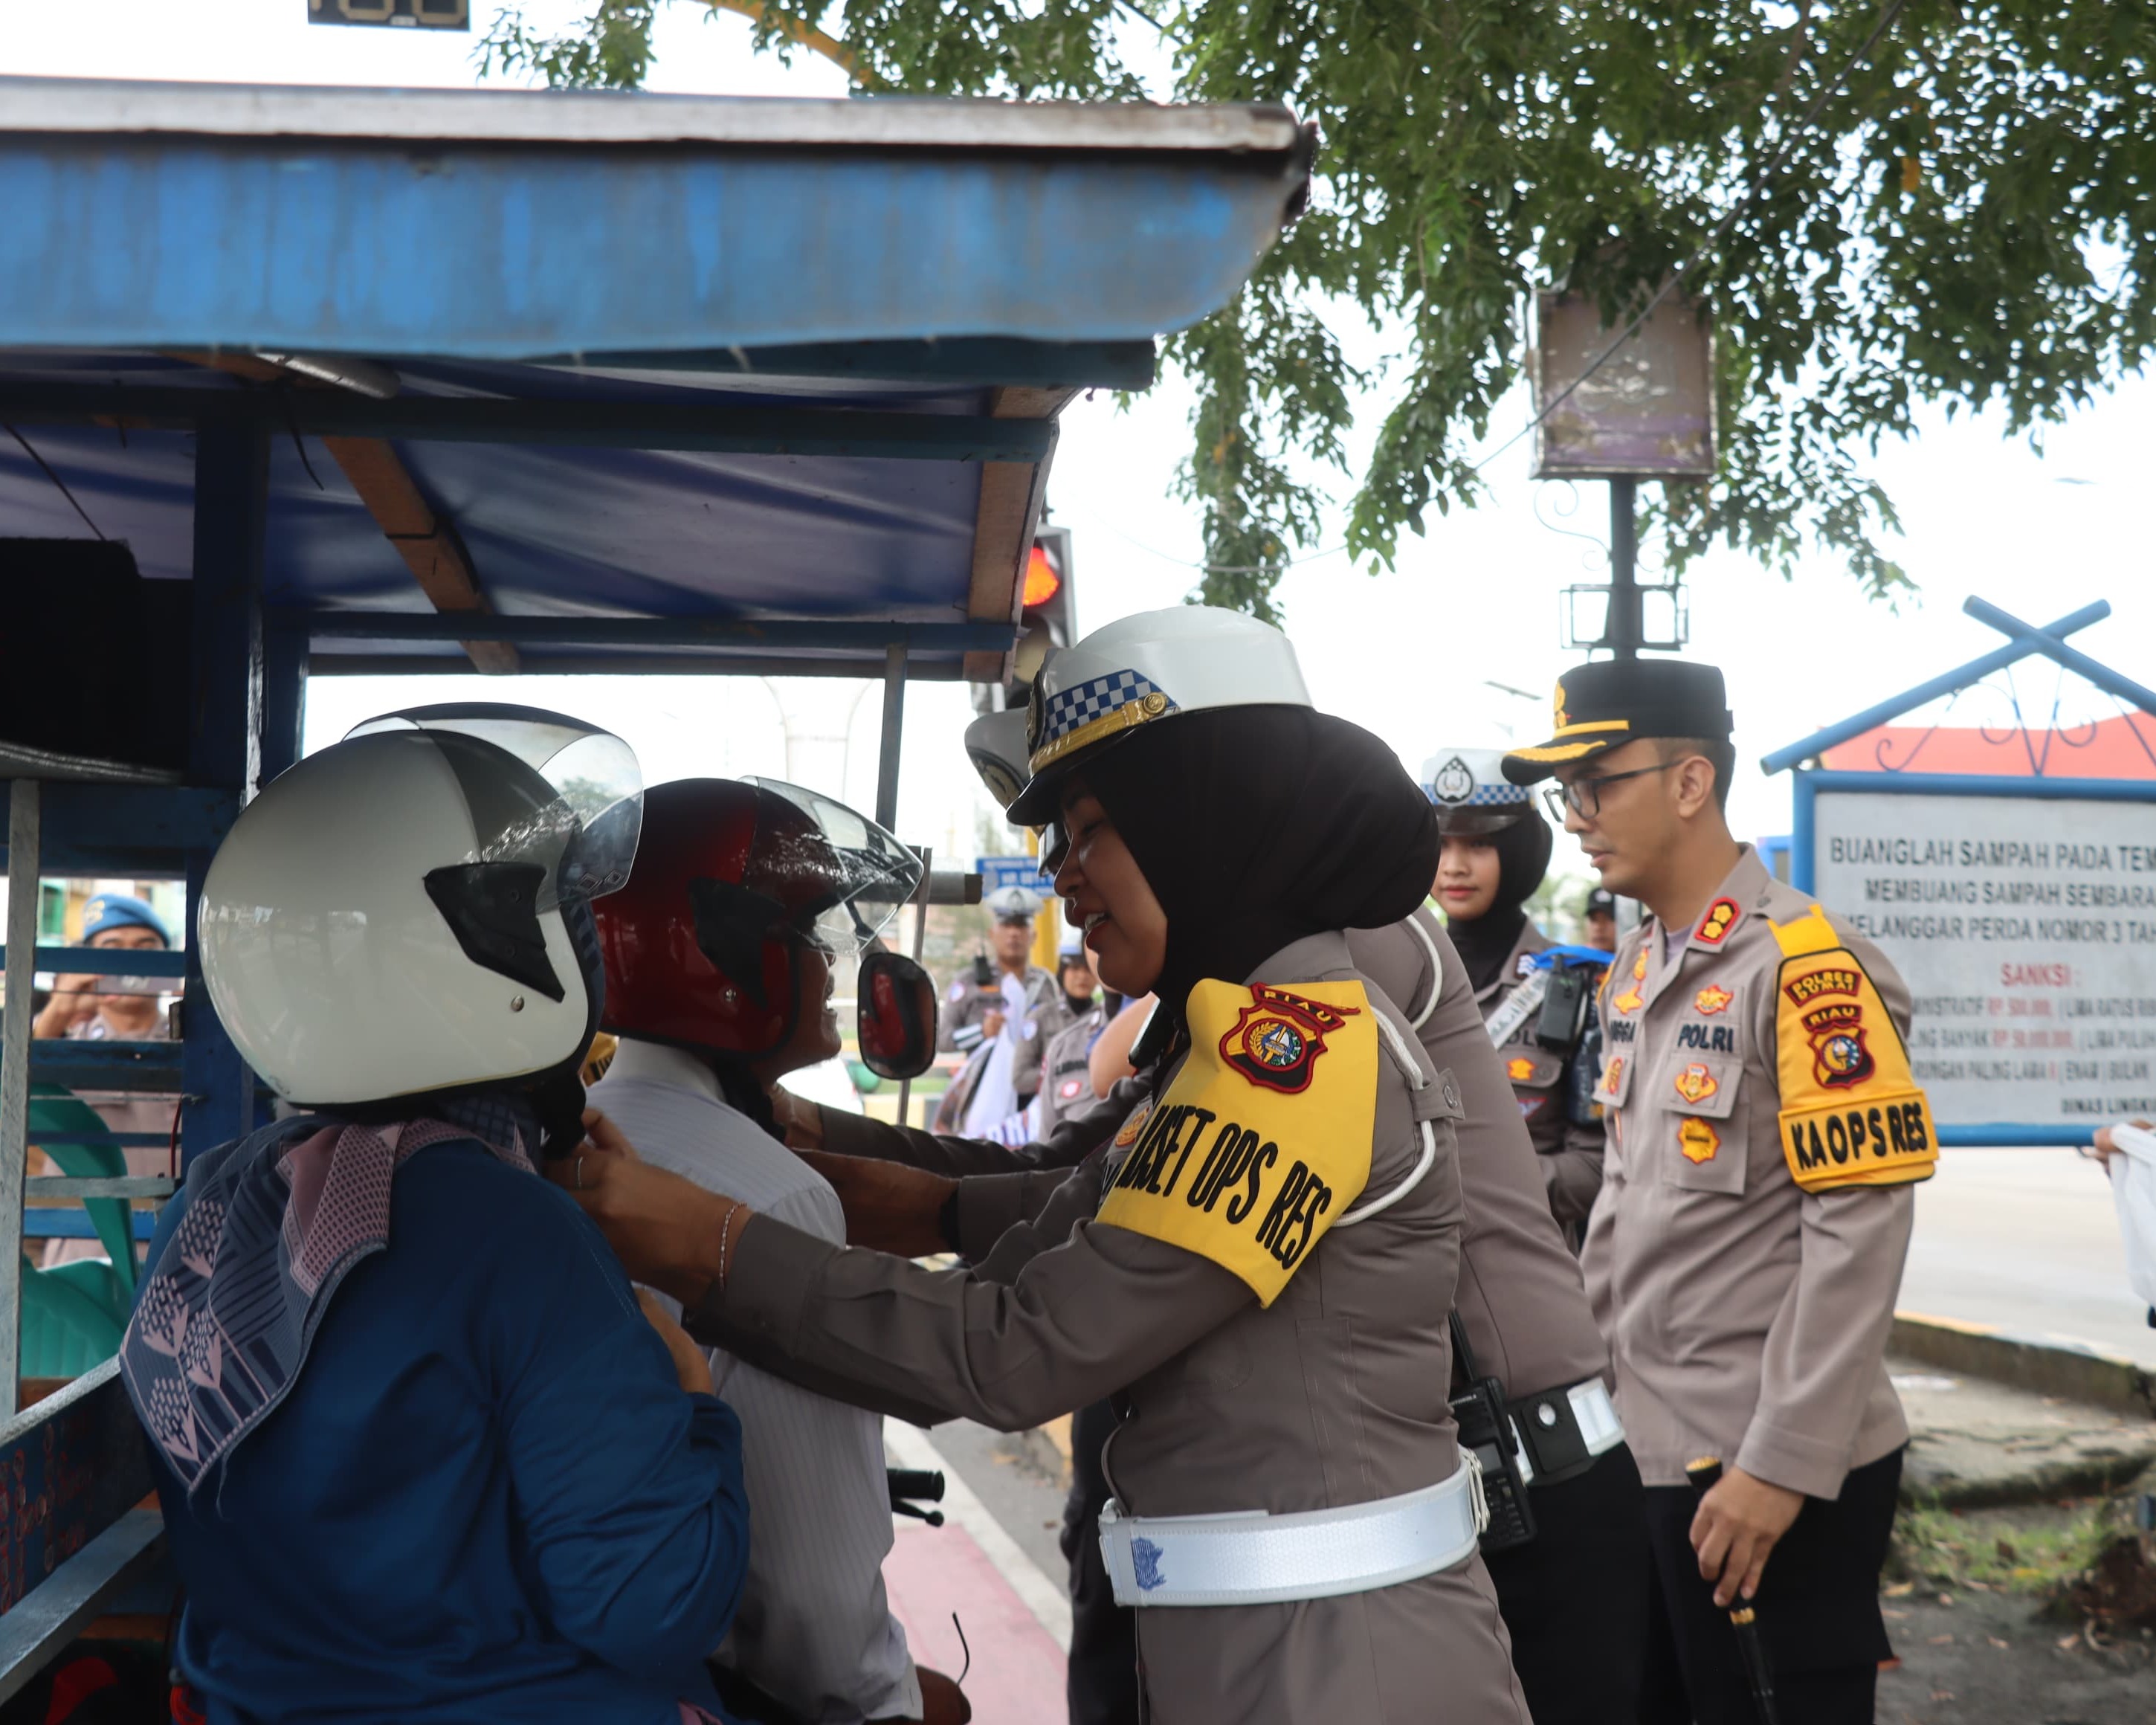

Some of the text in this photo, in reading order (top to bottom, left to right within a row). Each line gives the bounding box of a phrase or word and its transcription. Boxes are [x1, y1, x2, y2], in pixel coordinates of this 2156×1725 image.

[1830, 837, 1954, 867] BUANGLAH
[1960, 841, 2050, 868] SAMPAH
[2056, 844, 2113, 871] PADA
[1865, 879, 1976, 904] MEMBUANG
[1981, 881, 2061, 906] SAMPAH
[1848, 914, 1963, 941] ELANGGAR
[1969, 917, 2033, 942] PERDA
[2038, 919, 2106, 944] NOMOR
[1809, 1007, 1856, 1026] RIAU
[1677, 1022, 1734, 1053] POLRI
[1187, 1122, 1279, 1225] OPS
[1255, 1159, 1332, 1271] RES
